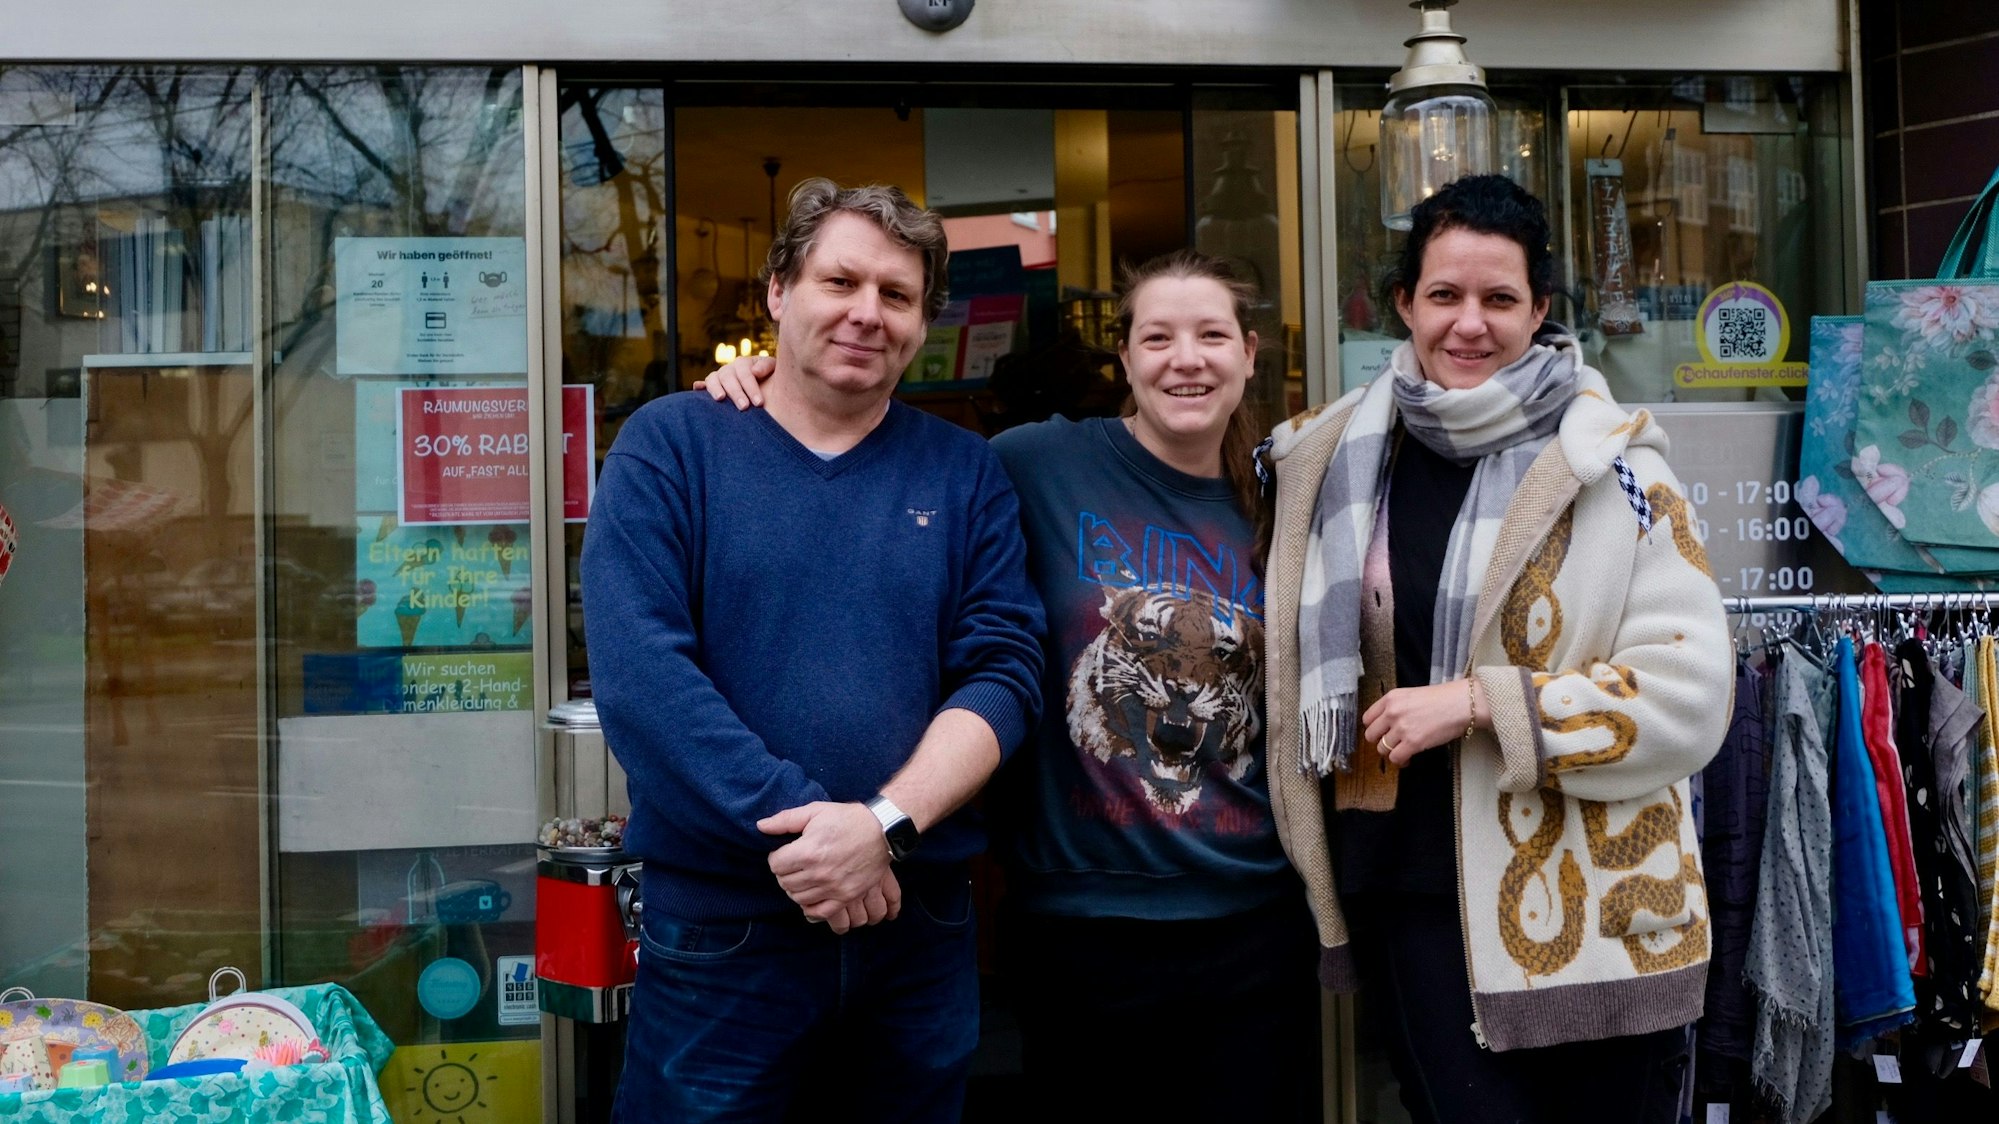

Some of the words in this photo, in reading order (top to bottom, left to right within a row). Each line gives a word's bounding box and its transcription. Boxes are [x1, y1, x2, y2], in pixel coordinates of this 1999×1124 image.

[1601, 184, 1625, 303] NAMASTE
[377, 251, 396, 261] Wir
[399, 250, 436, 261] haben
[438, 250, 492, 263] geöffnet!
[371, 280, 383, 289] 20
[423, 399, 527, 414] RÄUMUNGSVER
[413, 434, 472, 457] 30%
[479, 432, 574, 456] RABT
[443, 466, 465, 477] AUF
[507, 465, 528, 476] ALL
[1737, 517, 1810, 541] 16:00
[368, 543, 441, 563] Eltern
[452, 542, 529, 562] haften
[400, 566, 436, 585] für
[448, 566, 498, 585] Ihre
[1740, 567, 1813, 591] 17:00
[409, 589, 489, 609] Kinder!
[404, 662, 435, 677] Wir
[441, 661, 496, 676] suchen
[401, 679, 456, 695] ondere
[461, 677, 528, 693] 2-Hand-
[402, 695, 502, 711] menkleidung
[507, 693, 518, 708] &
